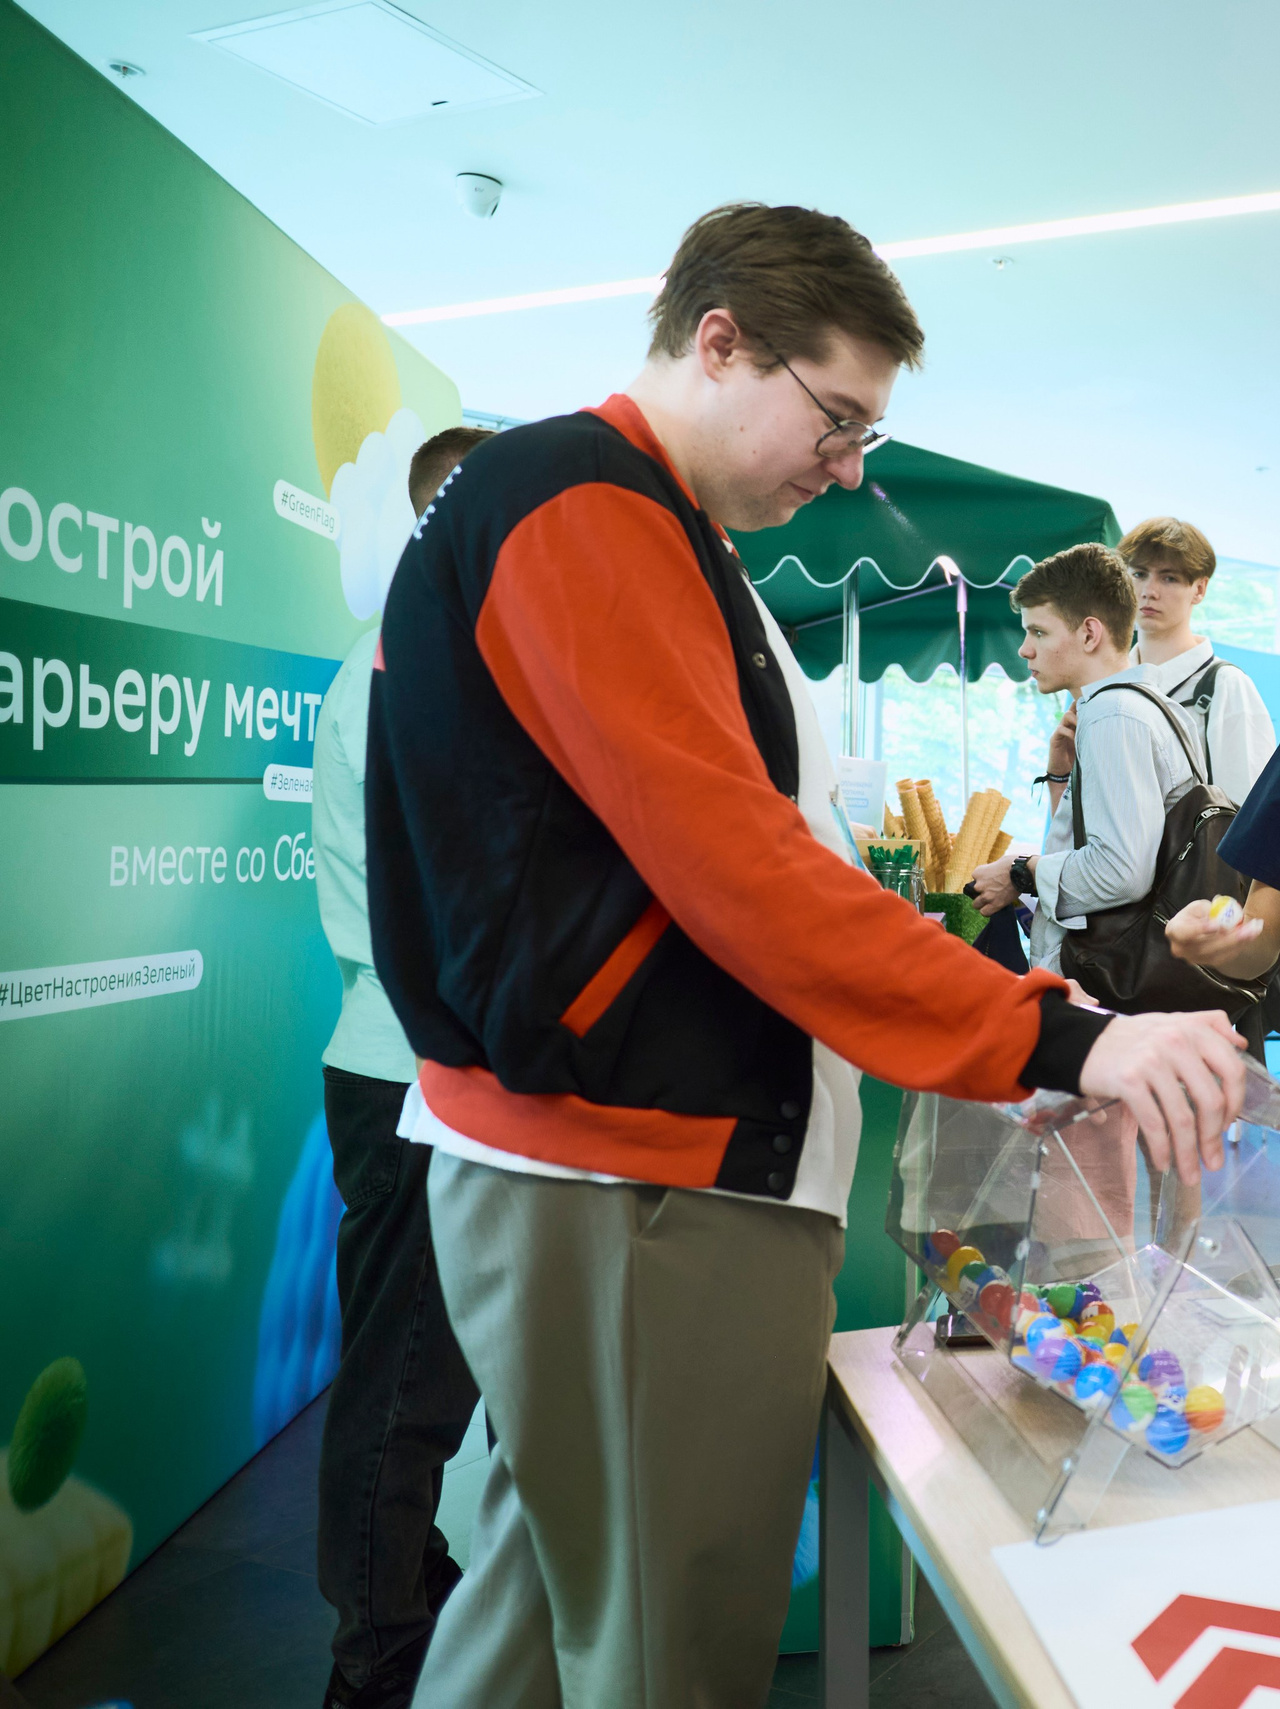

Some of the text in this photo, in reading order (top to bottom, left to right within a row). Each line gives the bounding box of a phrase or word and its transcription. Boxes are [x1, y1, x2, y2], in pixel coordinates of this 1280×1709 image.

[281, 490, 335, 533] #GreenFlag
[224, 682, 326, 742] мечт
[110, 842, 227, 887] вместе
[236, 845, 265, 883] со
[0, 957, 196, 1008] #ЦветНастроенияЗеленый
